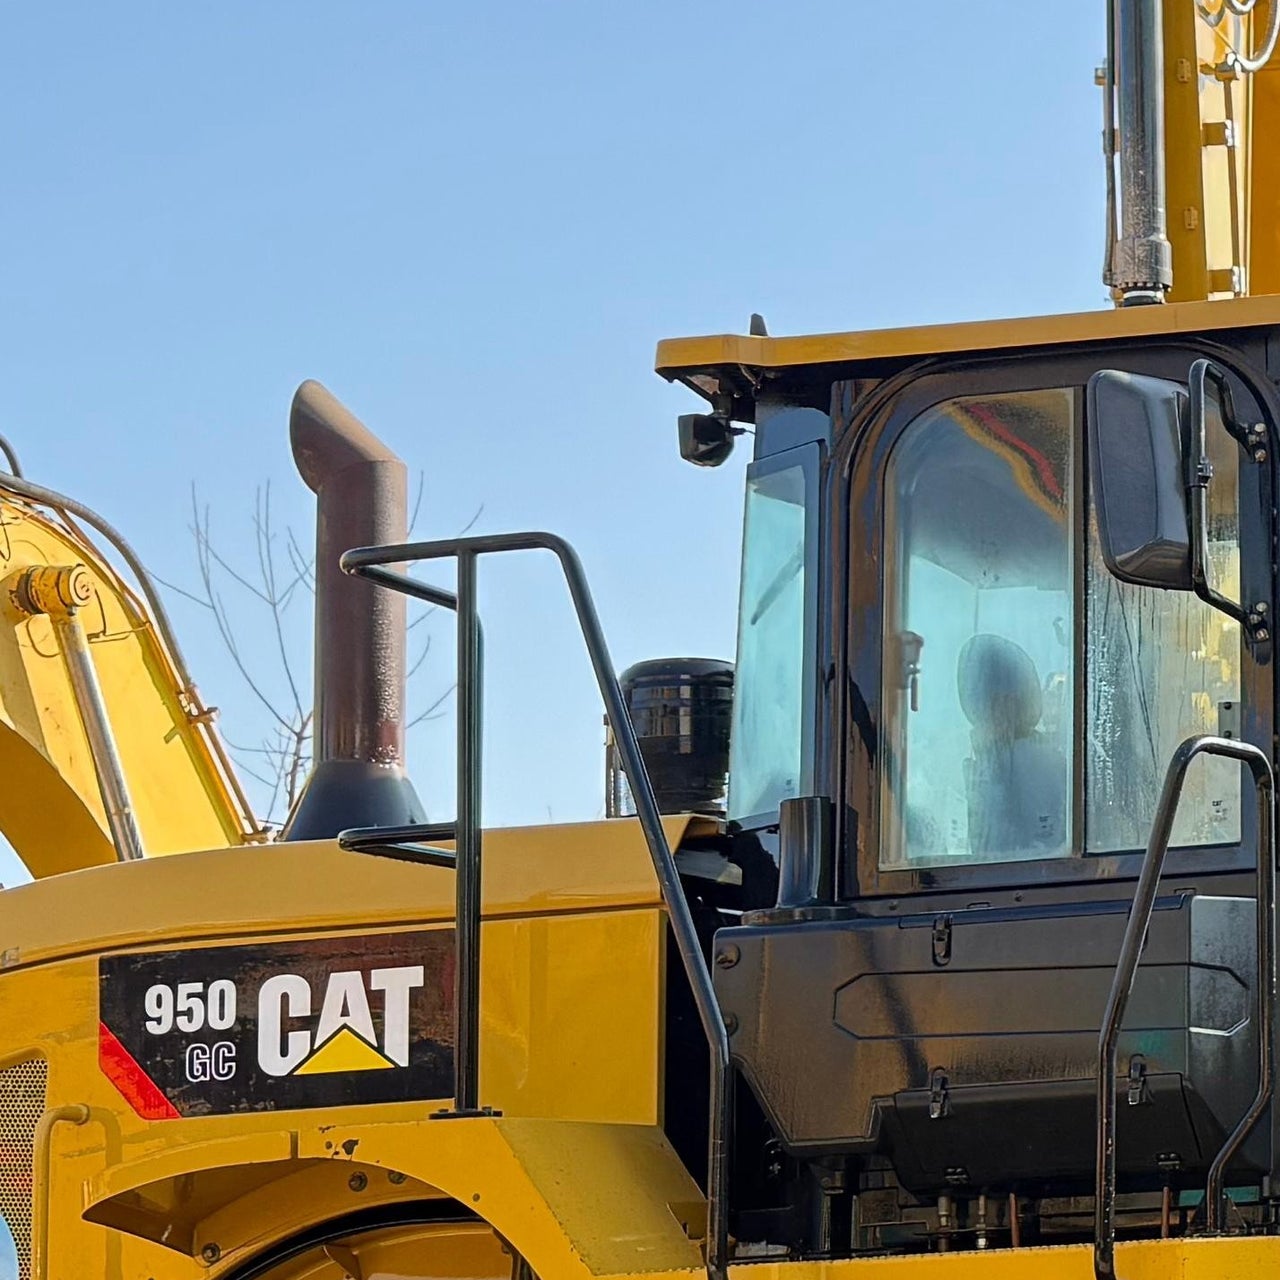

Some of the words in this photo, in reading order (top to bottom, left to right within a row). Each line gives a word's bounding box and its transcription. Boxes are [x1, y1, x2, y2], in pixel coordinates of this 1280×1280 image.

[145, 980, 236, 1035] 950
[257, 965, 425, 1077] CAT
[186, 1042, 236, 1082] GC
